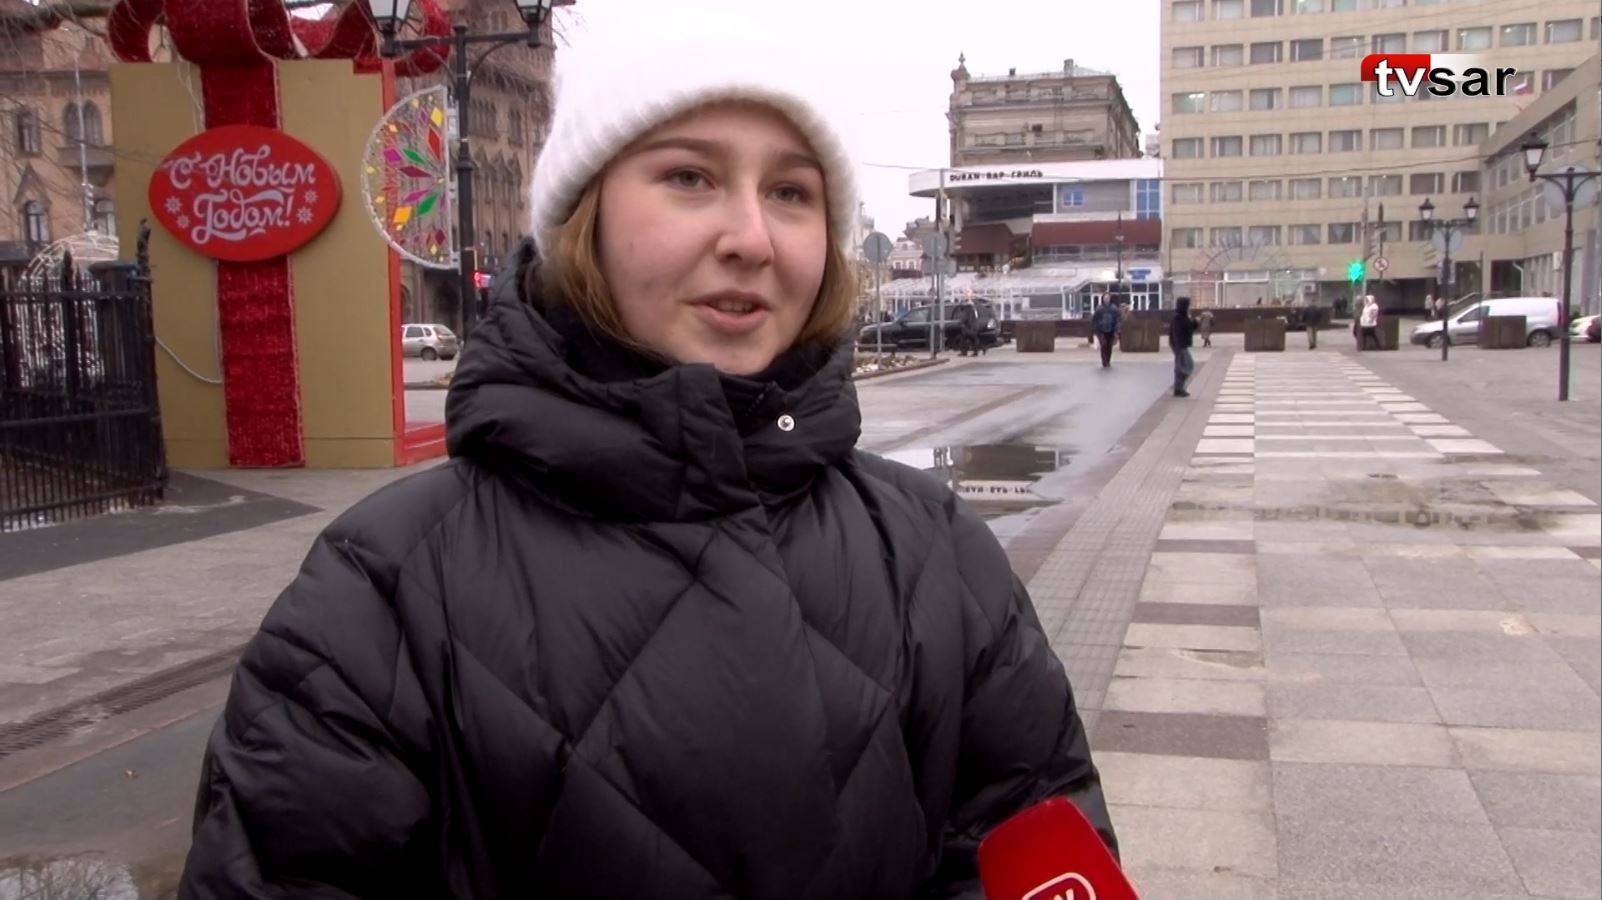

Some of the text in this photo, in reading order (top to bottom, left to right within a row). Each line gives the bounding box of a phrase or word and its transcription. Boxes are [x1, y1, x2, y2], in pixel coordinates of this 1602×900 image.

[163, 144, 316, 193] С Новым
[191, 188, 295, 245] Годом!
